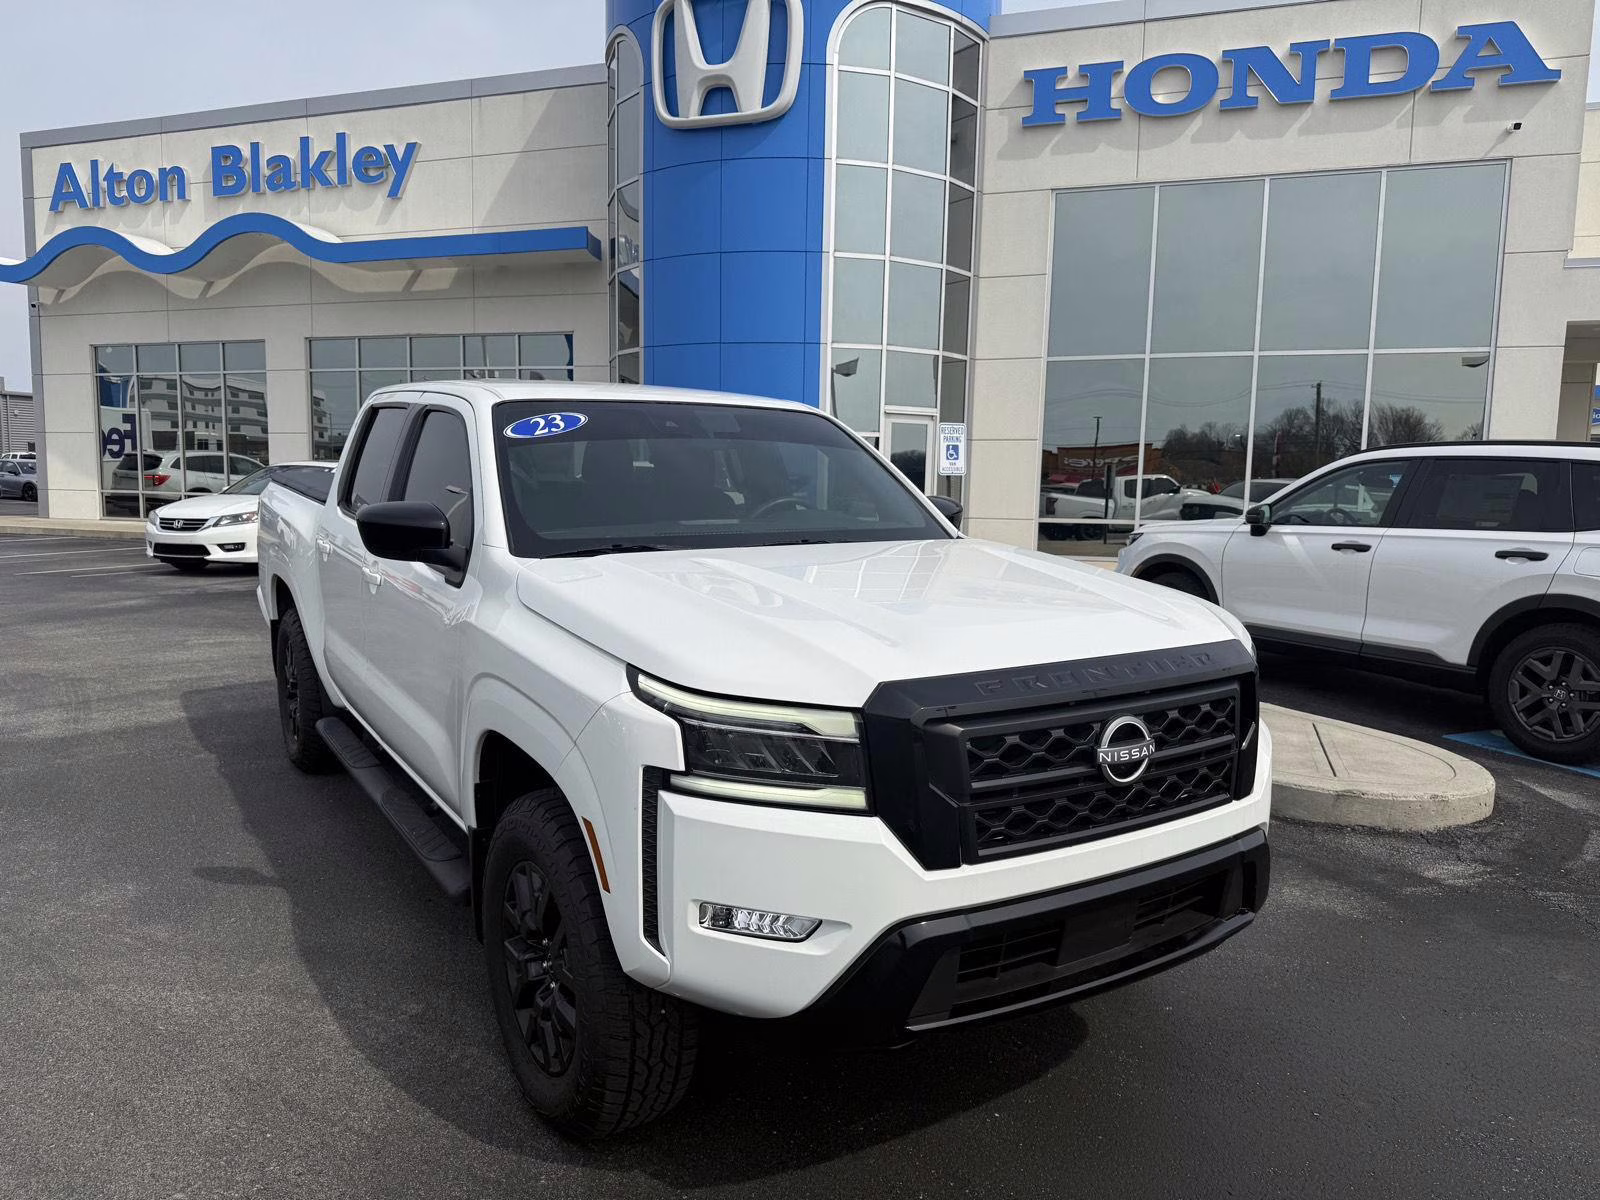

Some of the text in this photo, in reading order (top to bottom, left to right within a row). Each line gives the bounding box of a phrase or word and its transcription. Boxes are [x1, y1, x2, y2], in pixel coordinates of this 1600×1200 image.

[1021, 20, 1562, 127] HONDA
[48, 132, 422, 213] Alton Blakley
[530, 414, 565, 436] 23
[941, 426, 964, 435] RESERVED
[943, 435, 962, 443] PARKING
[973, 652, 1213, 696] FRONTIER
[1099, 742, 1156, 763] NISSAN
